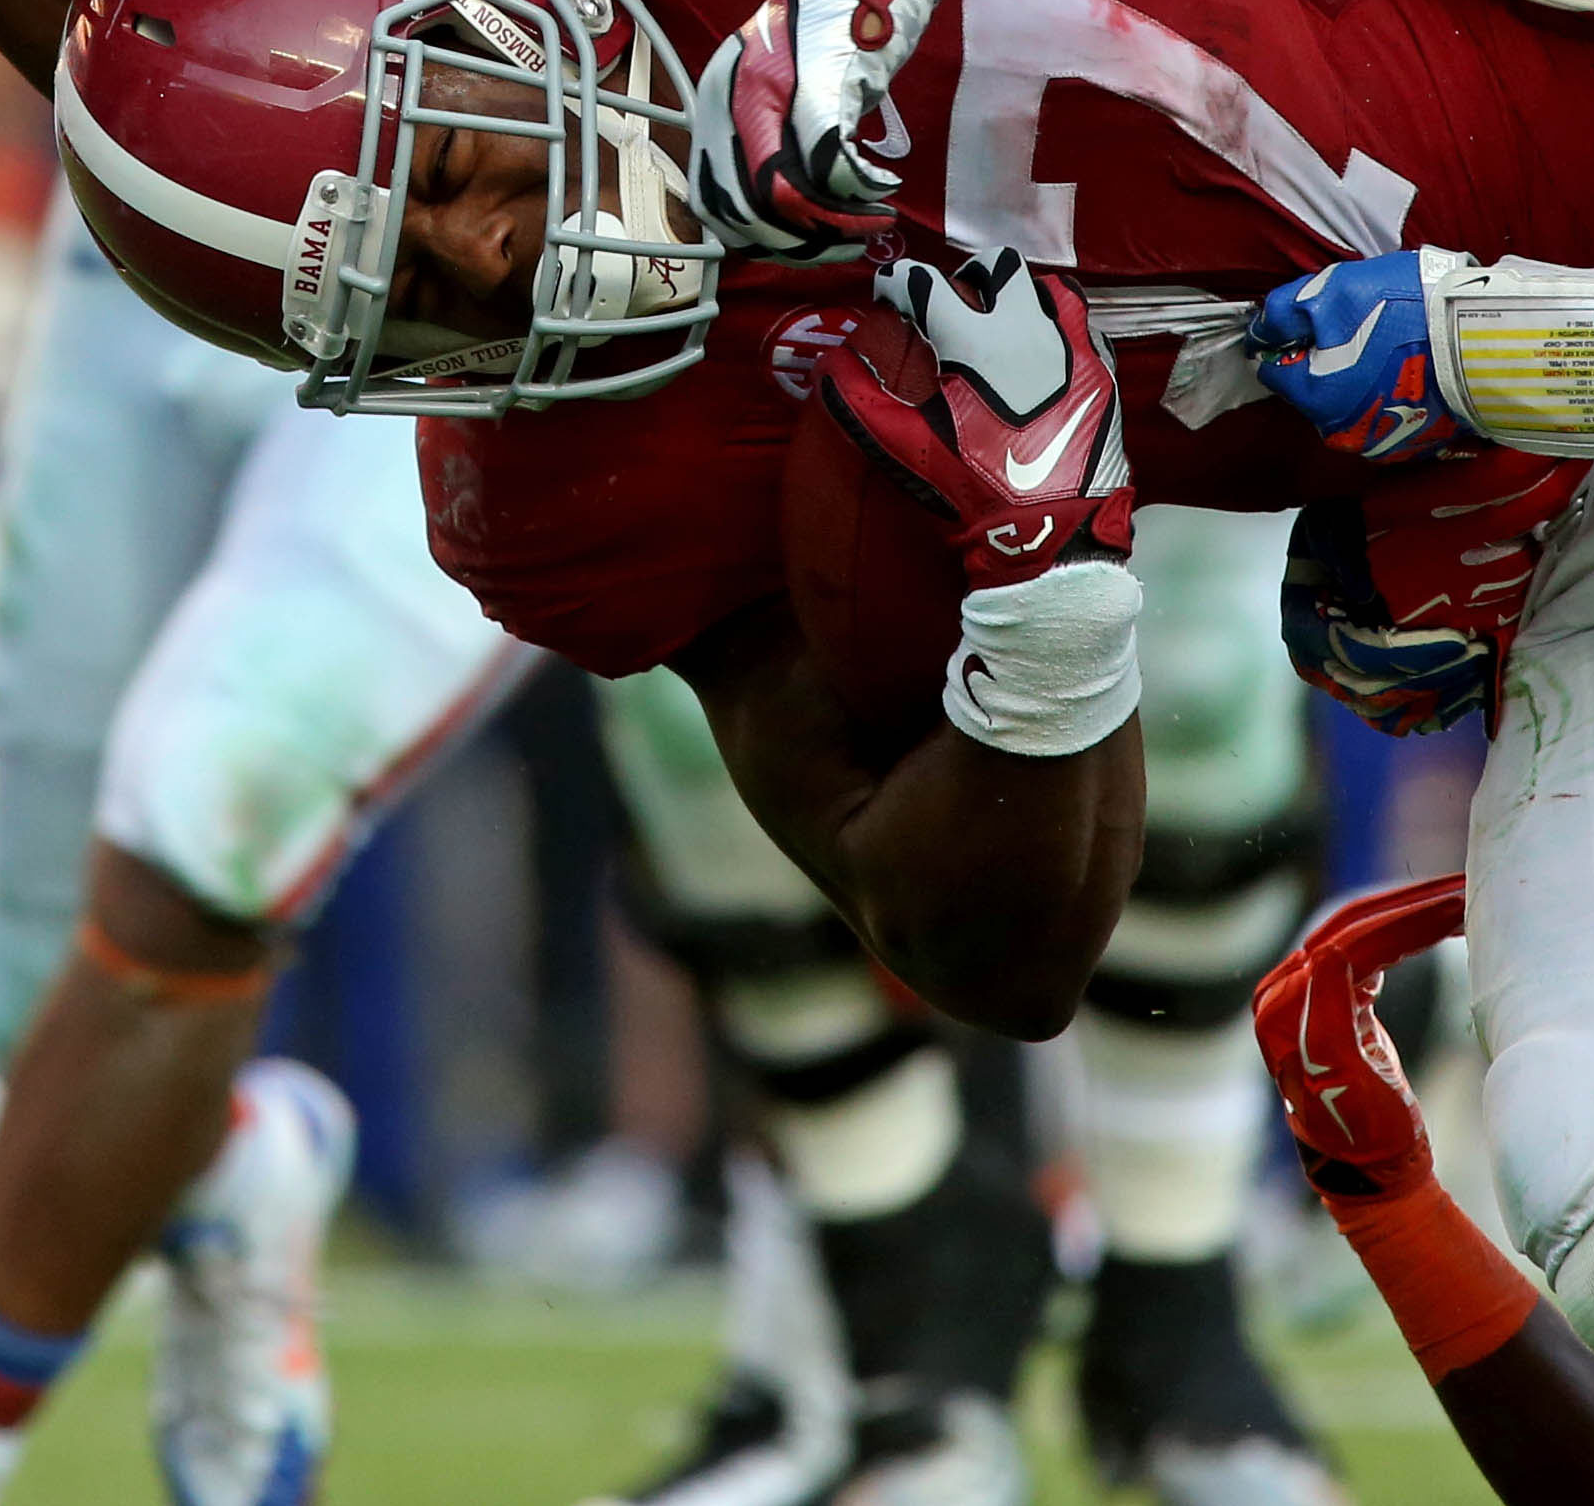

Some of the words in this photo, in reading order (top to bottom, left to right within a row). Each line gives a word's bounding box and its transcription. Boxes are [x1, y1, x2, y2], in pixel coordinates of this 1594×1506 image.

[472, 4, 547, 74] RIMSON
[294, 218, 333, 296] BAMA
[471, 340, 524, 364] TIDE
